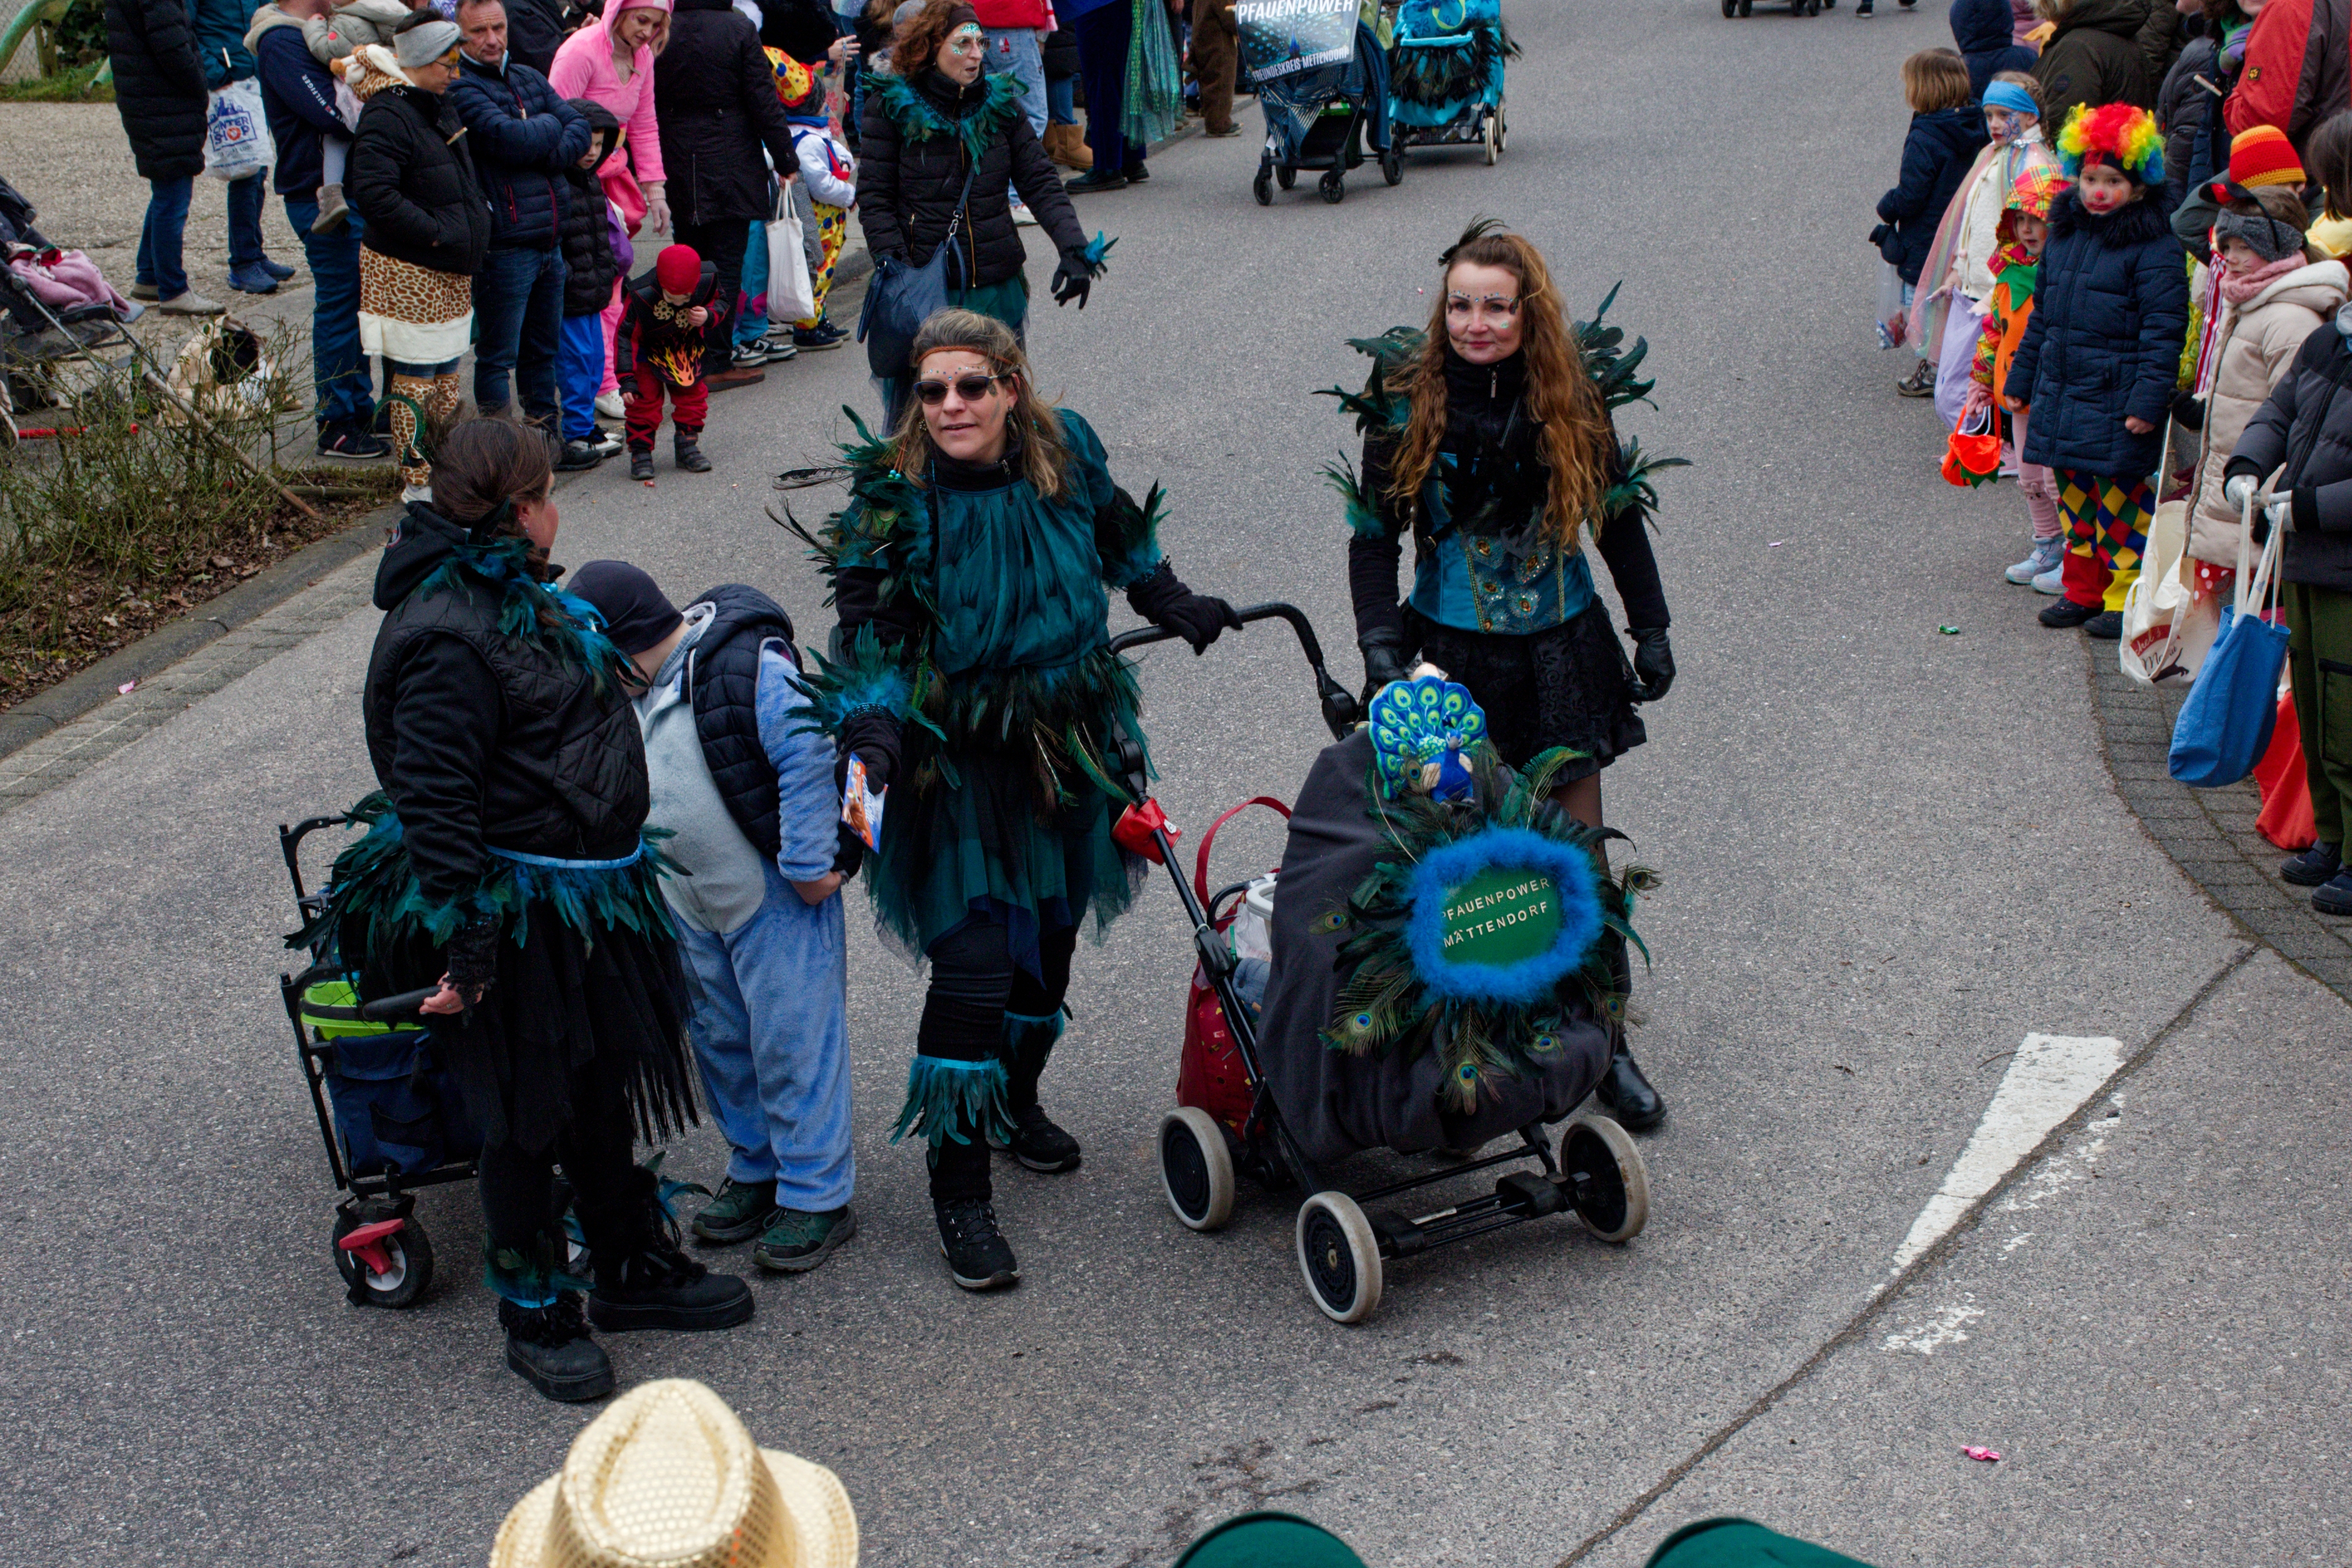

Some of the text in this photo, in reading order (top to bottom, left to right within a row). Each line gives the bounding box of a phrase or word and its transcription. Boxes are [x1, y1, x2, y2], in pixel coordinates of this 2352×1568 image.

[1238, 0, 1353, 24] PFAUENPOWER
[1252, 47, 1349, 82] FREUNDESKREIS METTENDORF
[302, 74, 327, 106] HILFIGER
[214, 116, 249, 134] CNTER
